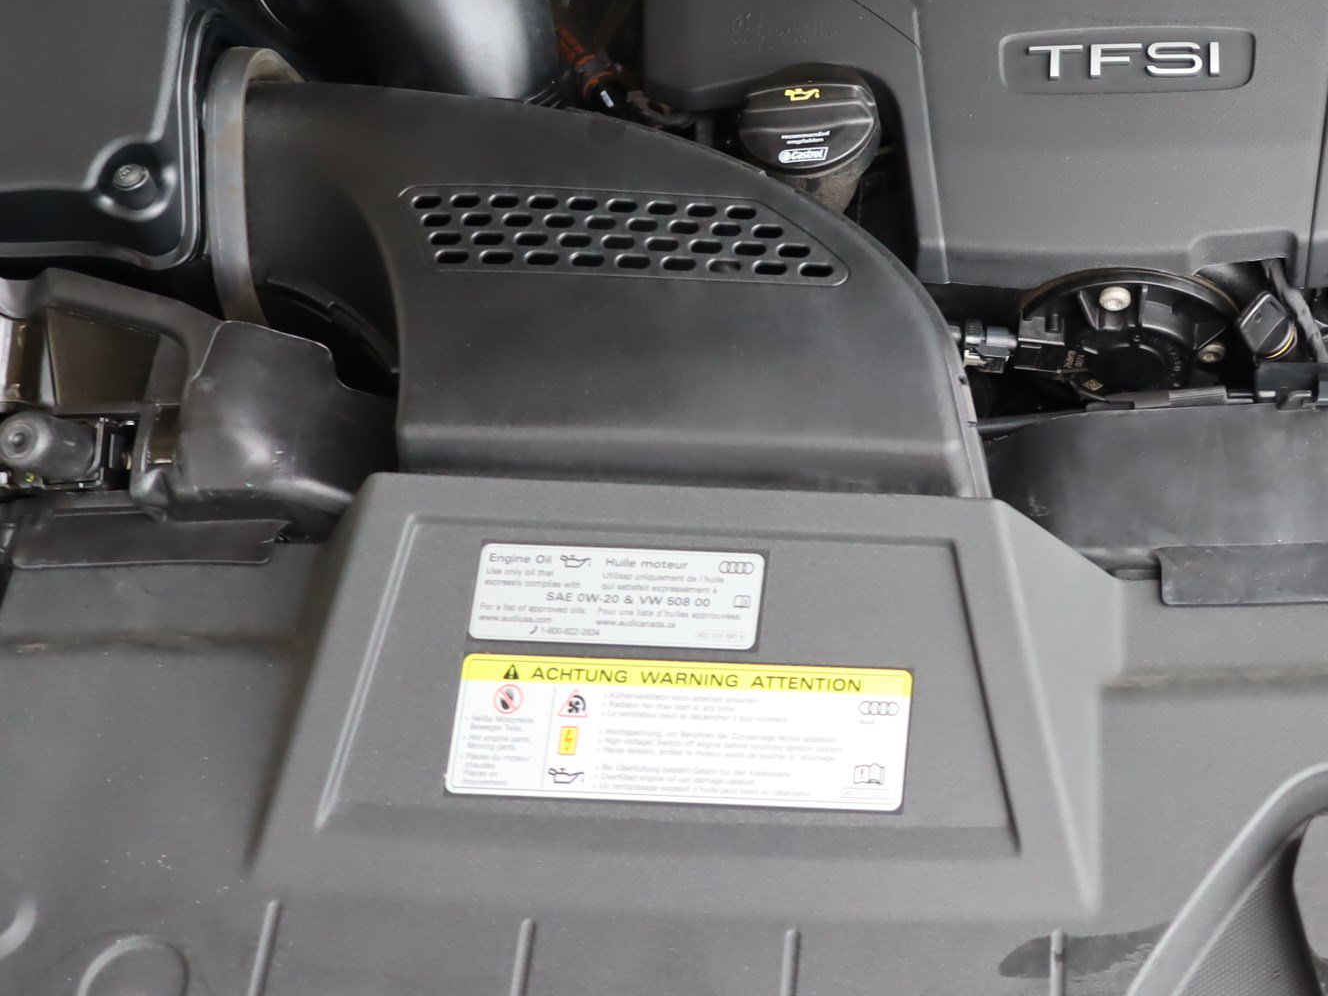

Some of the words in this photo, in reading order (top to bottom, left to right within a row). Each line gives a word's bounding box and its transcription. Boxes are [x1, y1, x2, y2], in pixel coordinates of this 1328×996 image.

[1027, 40, 1221, 82] TFSI
[781, 131, 830, 140] recommended
[791, 149, 824, 160] Castrol
[488, 552, 530, 564] Engine
[535, 554, 552, 563] Oil
[605, 557, 636, 567] Huile
[640, 560, 688, 569] moteur
[503, 568, 521, 576] only
[546, 592, 572, 601] SAE
[576, 593, 619, 603] 0W-20
[623, 595, 633, 603] &
[638, 595, 662, 605] VW
[666, 596, 690, 606] 508
[694, 597, 710, 606] 00
[531, 667, 628, 683] ACHTUNG
[641, 672, 739, 688] WARNING
[751, 676, 863, 692] ATTENTION
